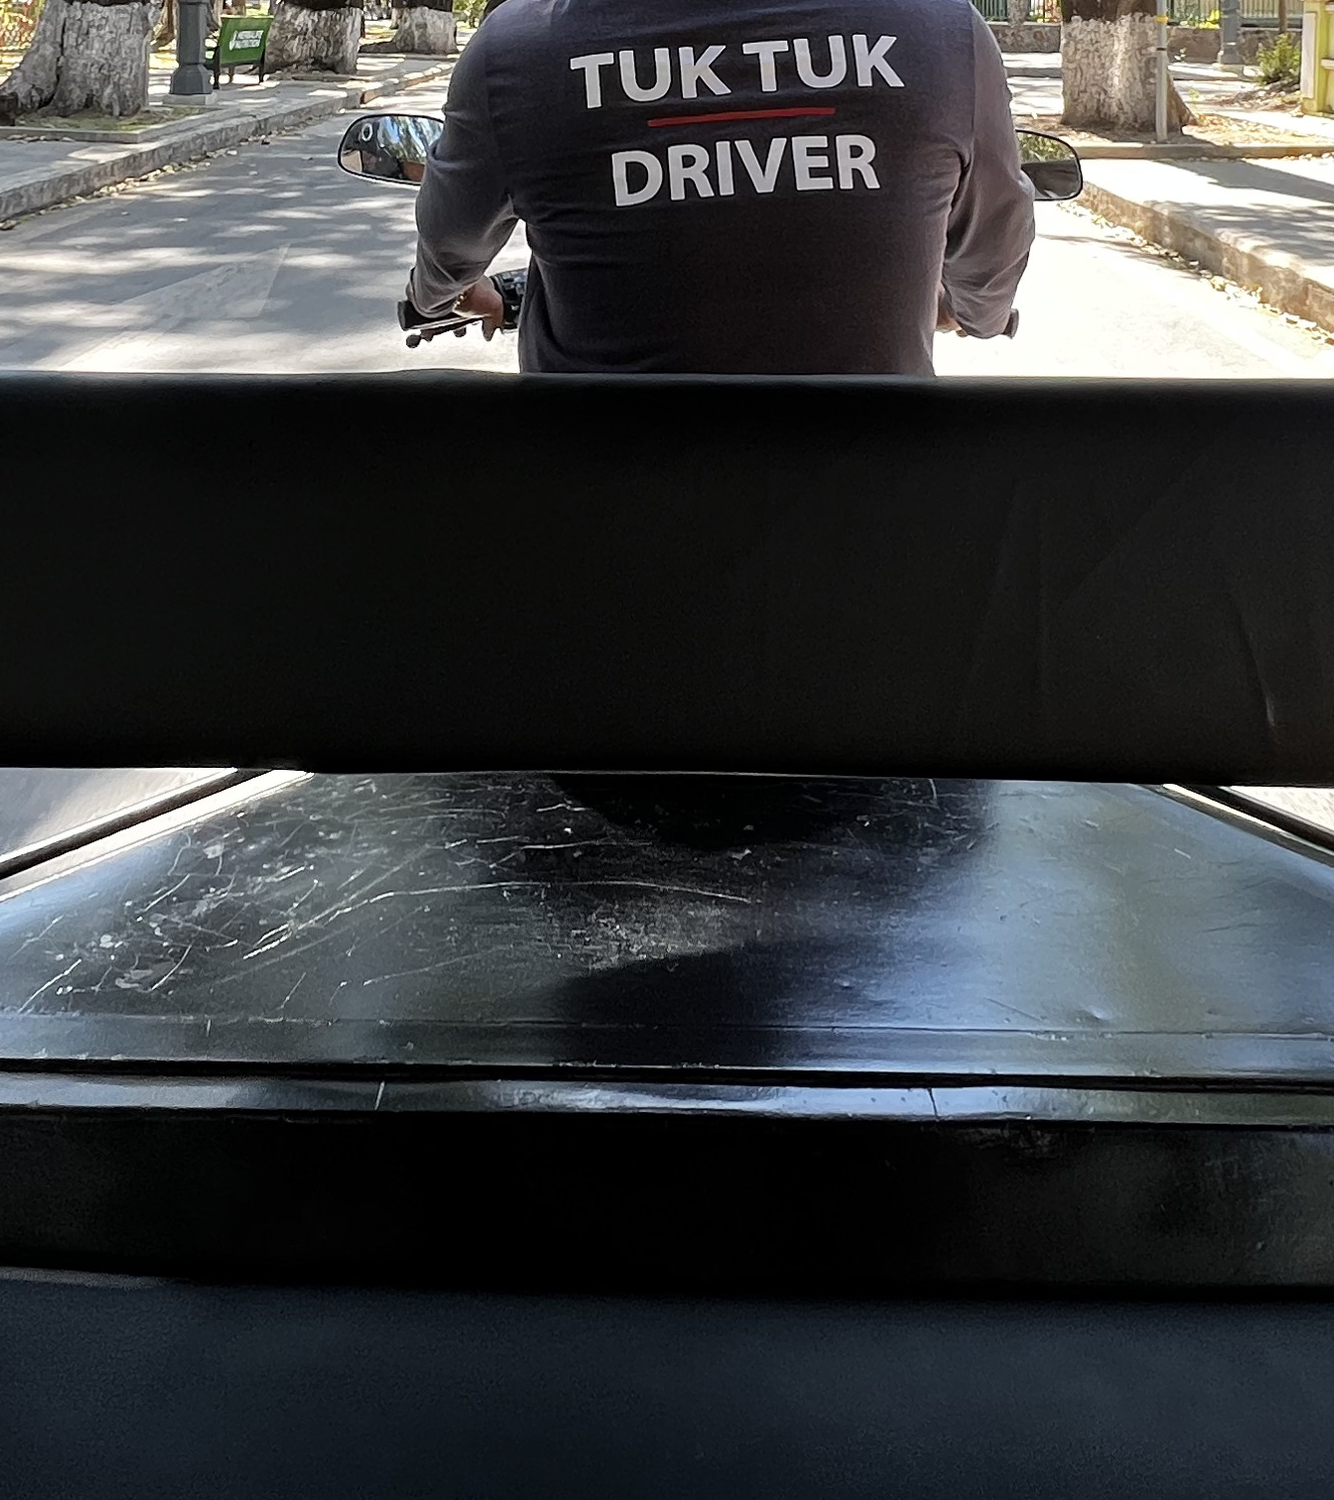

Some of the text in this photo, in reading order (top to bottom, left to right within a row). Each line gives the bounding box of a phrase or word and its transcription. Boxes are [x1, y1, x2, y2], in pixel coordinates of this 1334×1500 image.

[570, 34, 905, 109] TUK TUK
[611, 134, 881, 207] DRIVER
